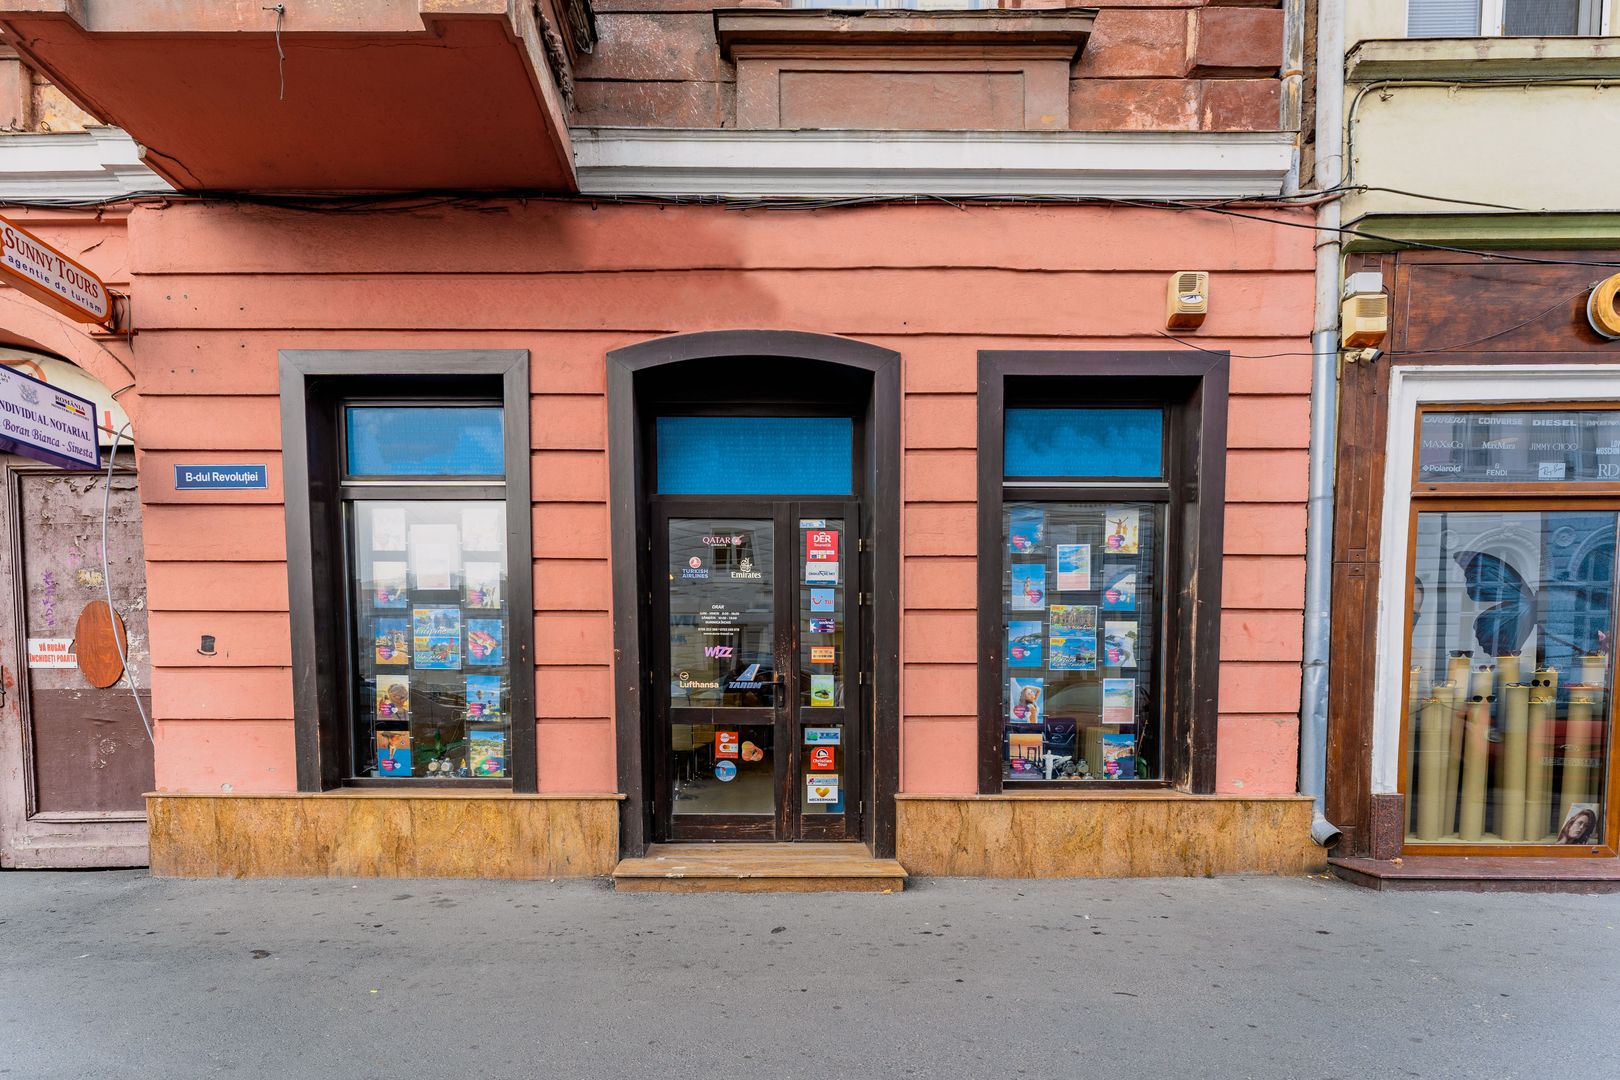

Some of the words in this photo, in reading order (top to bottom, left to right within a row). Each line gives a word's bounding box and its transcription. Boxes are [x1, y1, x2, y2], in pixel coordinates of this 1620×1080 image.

[5, 227, 53, 272] SUNNY
[56, 257, 98, 298] TOURS
[8, 255, 50, 283] agentie
[55, 281, 67, 293] de
[71, 290, 102, 313] turism
[0, 400, 49, 426] NDIVIDUAL
[50, 418, 91, 441] NOTARIAL
[1478, 417, 1523, 425] CONVERSE
[1532, 419, 1577, 427] DIESEL
[3, 419, 30, 437] Boran
[31, 429, 60, 447] Bianca
[67, 441, 93, 459] Sinesta
[1529, 443, 1551, 451] JIMMY
[1552, 442, 1578, 451] CHOO
[1429, 464, 1461, 472] Polaroid
[185, 472, 210, 482] B-dul
[702, 536, 731, 545] QATAR
[813, 534, 832, 543] DER
[731, 571, 762, 579] Emirates
[679, 680, 720, 689] Lufthansa
[728, 681, 762, 689] TAROM
